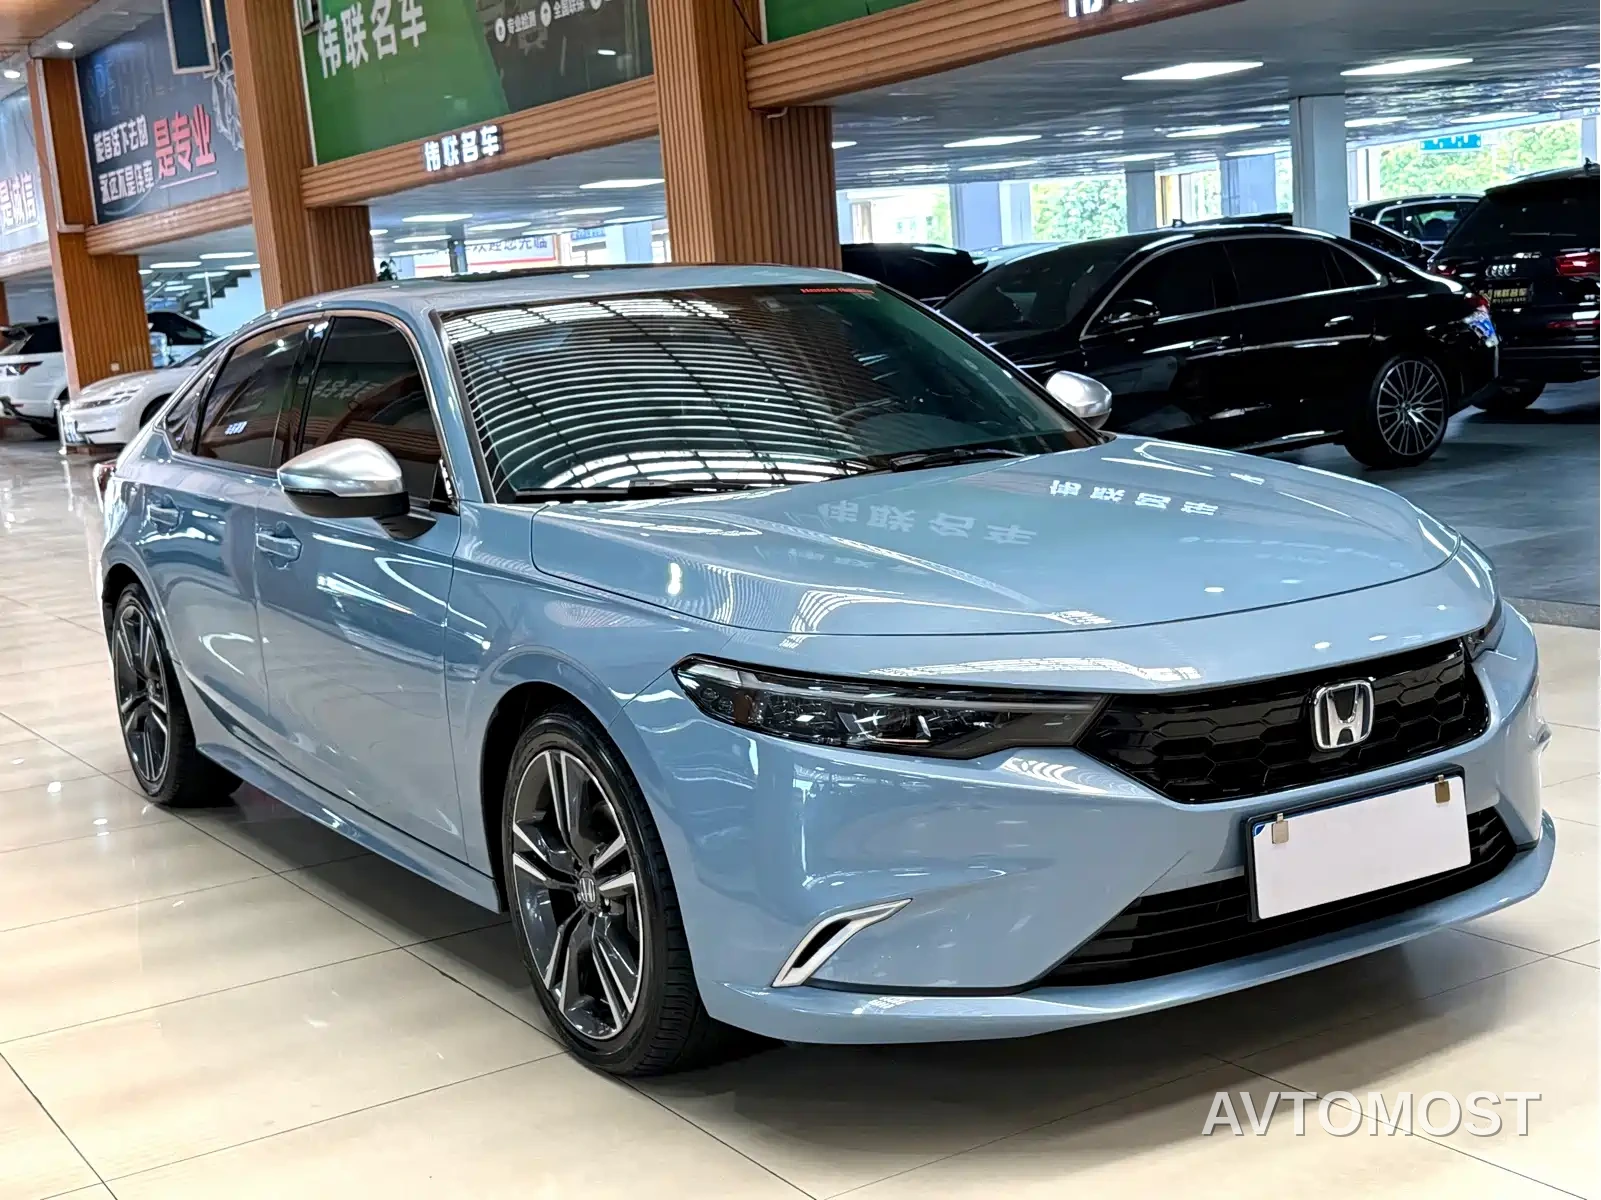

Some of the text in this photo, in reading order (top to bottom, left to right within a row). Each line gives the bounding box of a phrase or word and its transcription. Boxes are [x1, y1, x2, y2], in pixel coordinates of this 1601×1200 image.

[318, 0, 427, 78] 伟联名车
[153, 104, 216, 179] 是专业
[424, 125, 500, 172] 伟联名车
